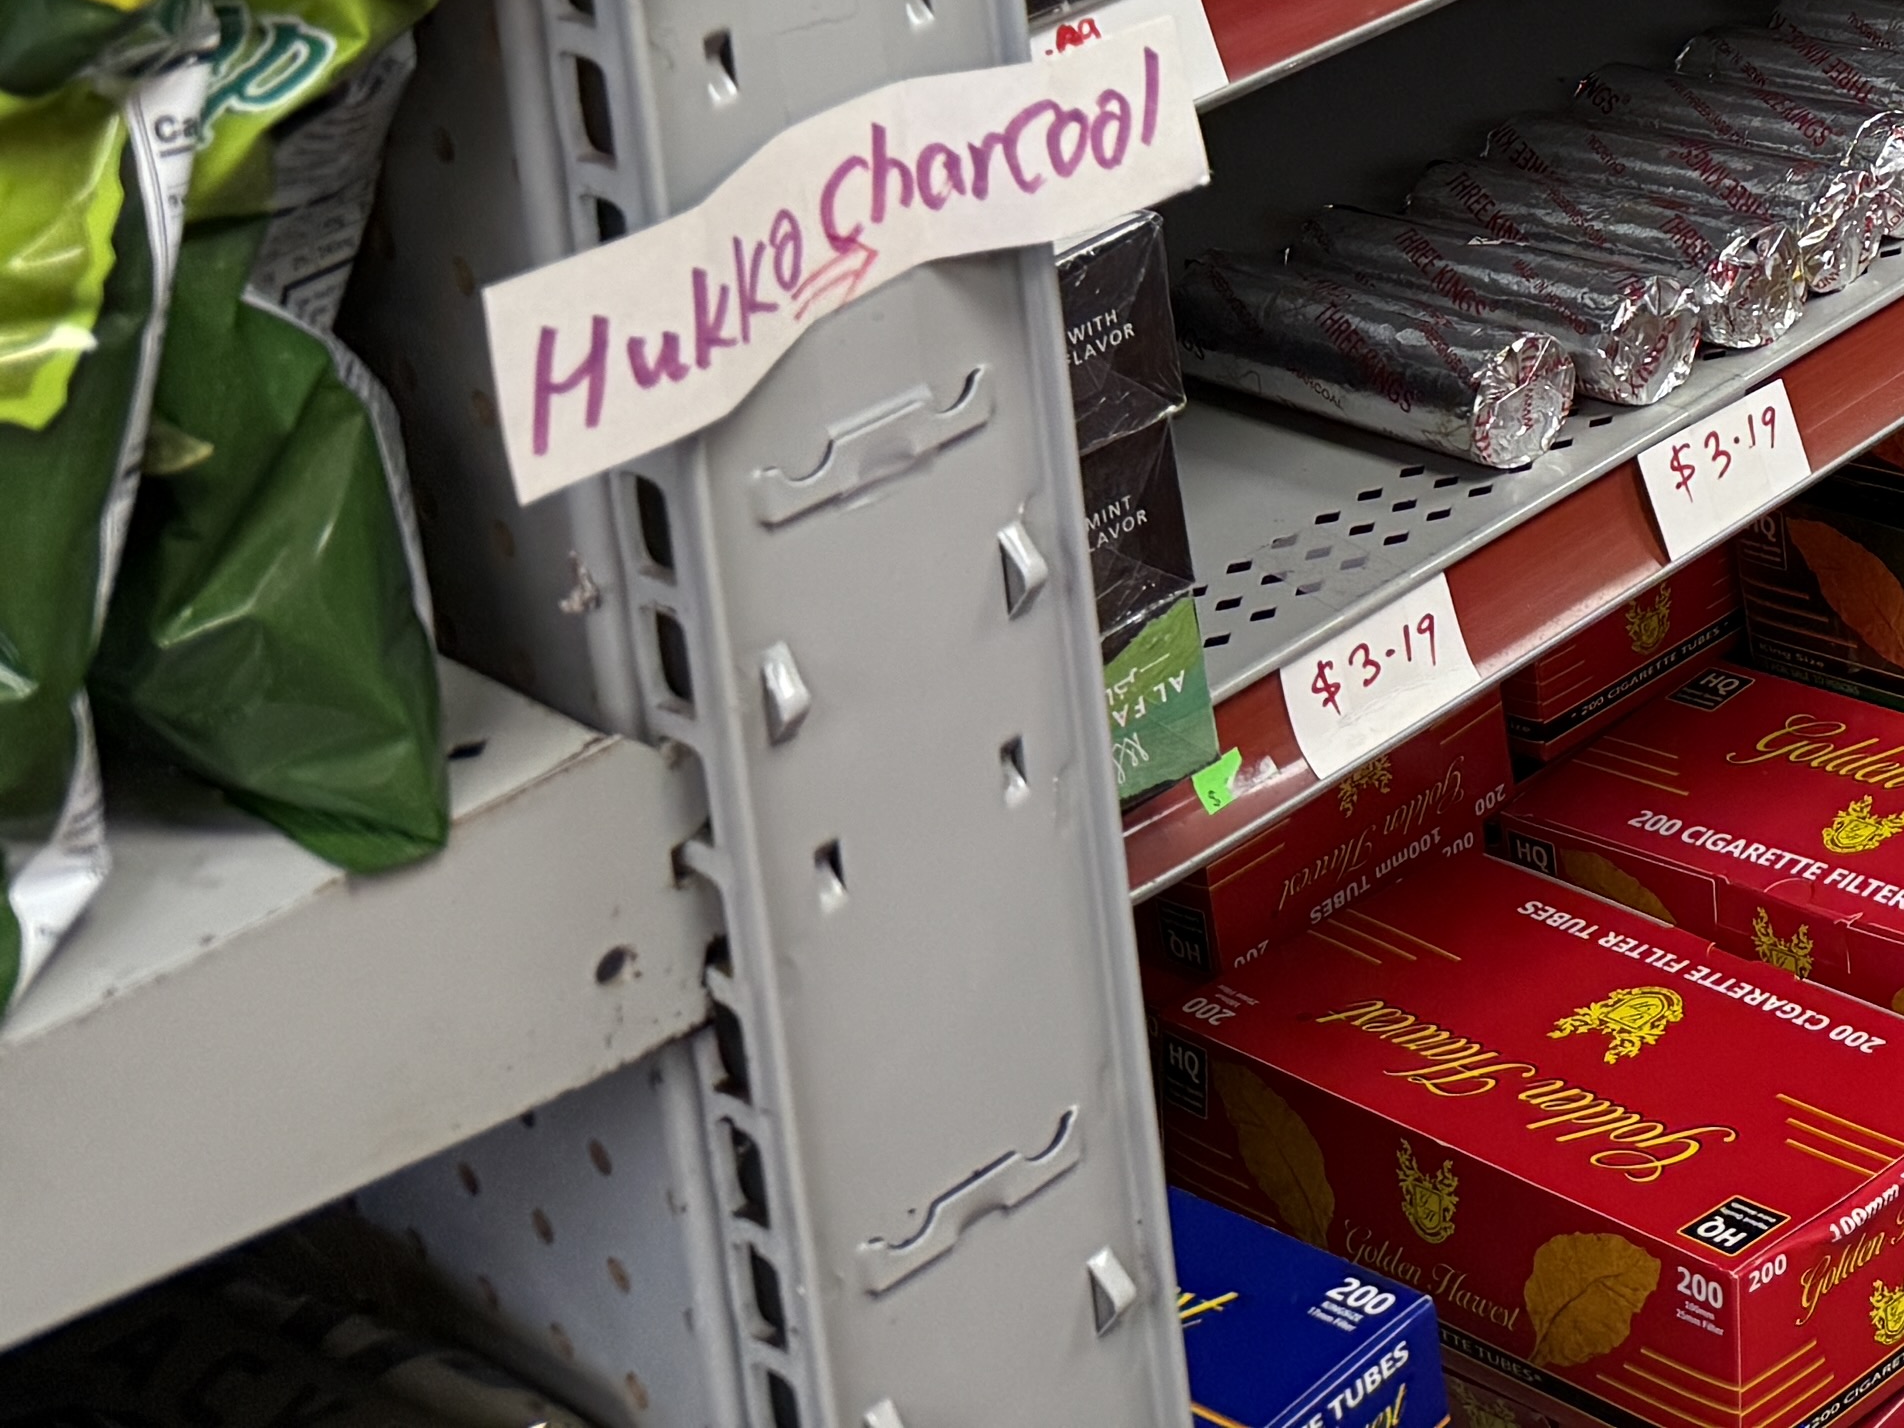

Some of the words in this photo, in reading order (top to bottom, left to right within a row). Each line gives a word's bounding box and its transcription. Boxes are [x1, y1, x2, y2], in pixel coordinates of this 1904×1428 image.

[531, 210, 802, 456] Hukka
[819, 46, 1161, 253] Charcoal
[1397, 227, 1446, 272] THREE
[1431, 262, 1488, 315] KINGS
[1668, 404, 1780, 500] $3.19
[1309, 612, 1442, 715] $3.19
[1627, 807, 1681, 840] 200
[1681, 820, 1820, 881] CIGARETTE
[1828, 1178, 1901, 1243] 100mm
[1324, 1276, 1398, 1319] 200
